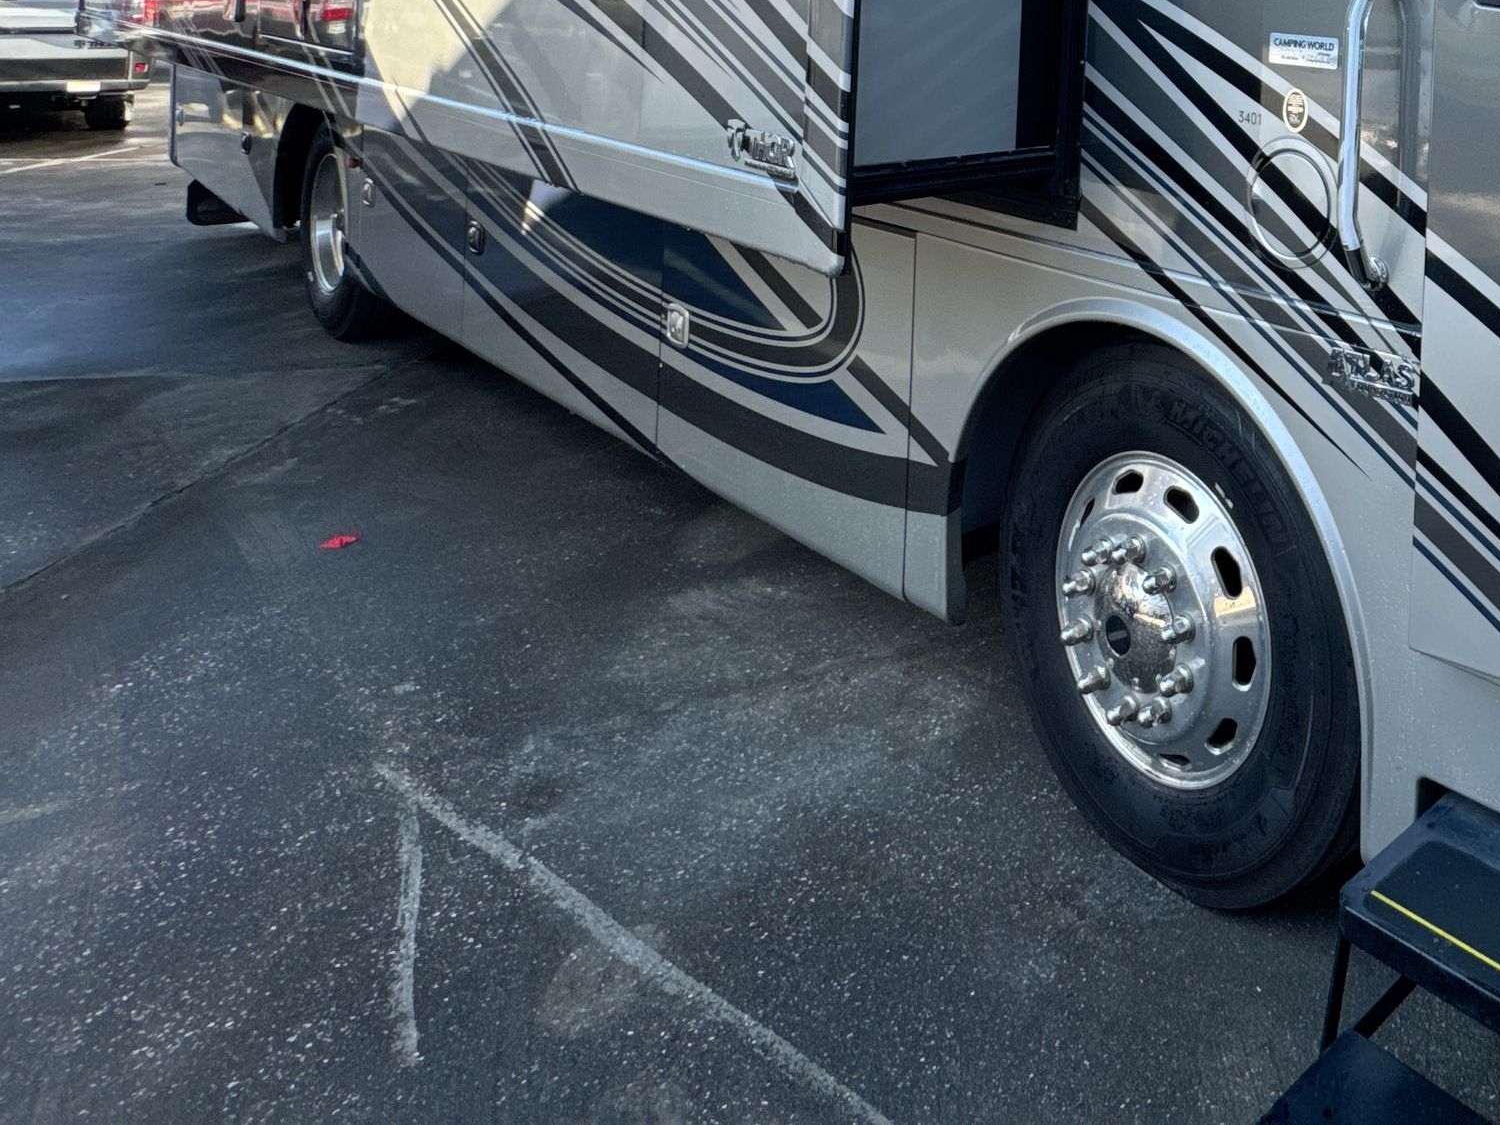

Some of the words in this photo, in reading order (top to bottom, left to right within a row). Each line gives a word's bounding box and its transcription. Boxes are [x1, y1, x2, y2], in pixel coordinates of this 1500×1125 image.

[1273, 37, 1306, 49] CAMPING
[1307, 41, 1335, 52] WORLD
[1238, 110, 1262, 126] 3401
[745, 128, 796, 169] THOR
[1168, 398, 1291, 543] MICHELIN
